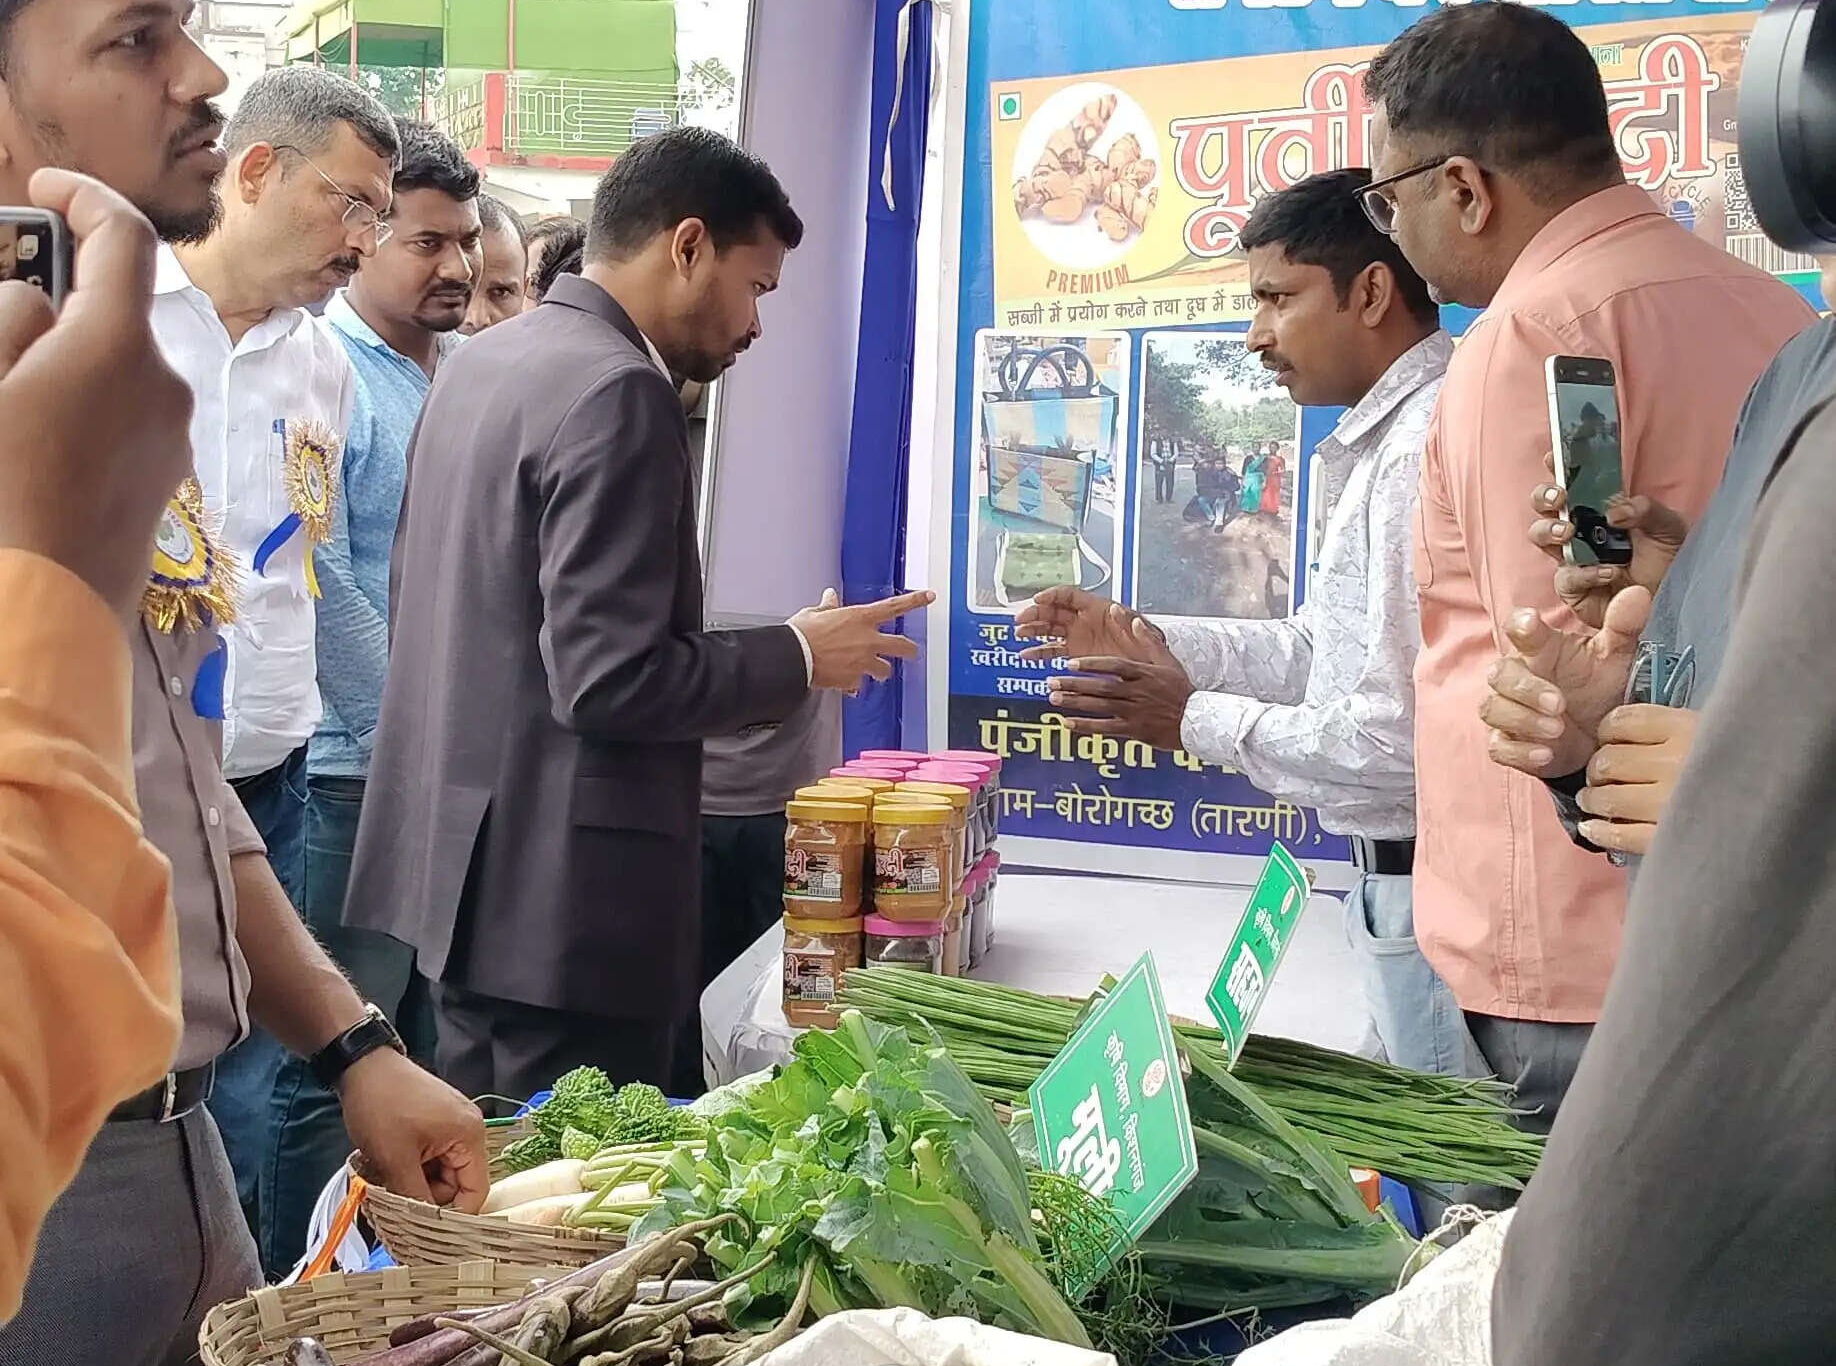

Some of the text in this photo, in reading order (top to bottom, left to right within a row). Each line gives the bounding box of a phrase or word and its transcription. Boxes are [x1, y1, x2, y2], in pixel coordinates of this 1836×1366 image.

[1046, 263, 1131, 295] PREMIUM
[1006, 301, 1045, 326] सब्जी
[1049, 299, 1062, 324] में
[1067, 300, 1110, 323] प्रयोग
[1115, 295, 1148, 319] करने
[1153, 298, 1181, 317] तथा
[1186, 296, 1208, 321] दूध
[1212, 288, 1226, 312] में
[1056, 1082, 1121, 1200] मूली
